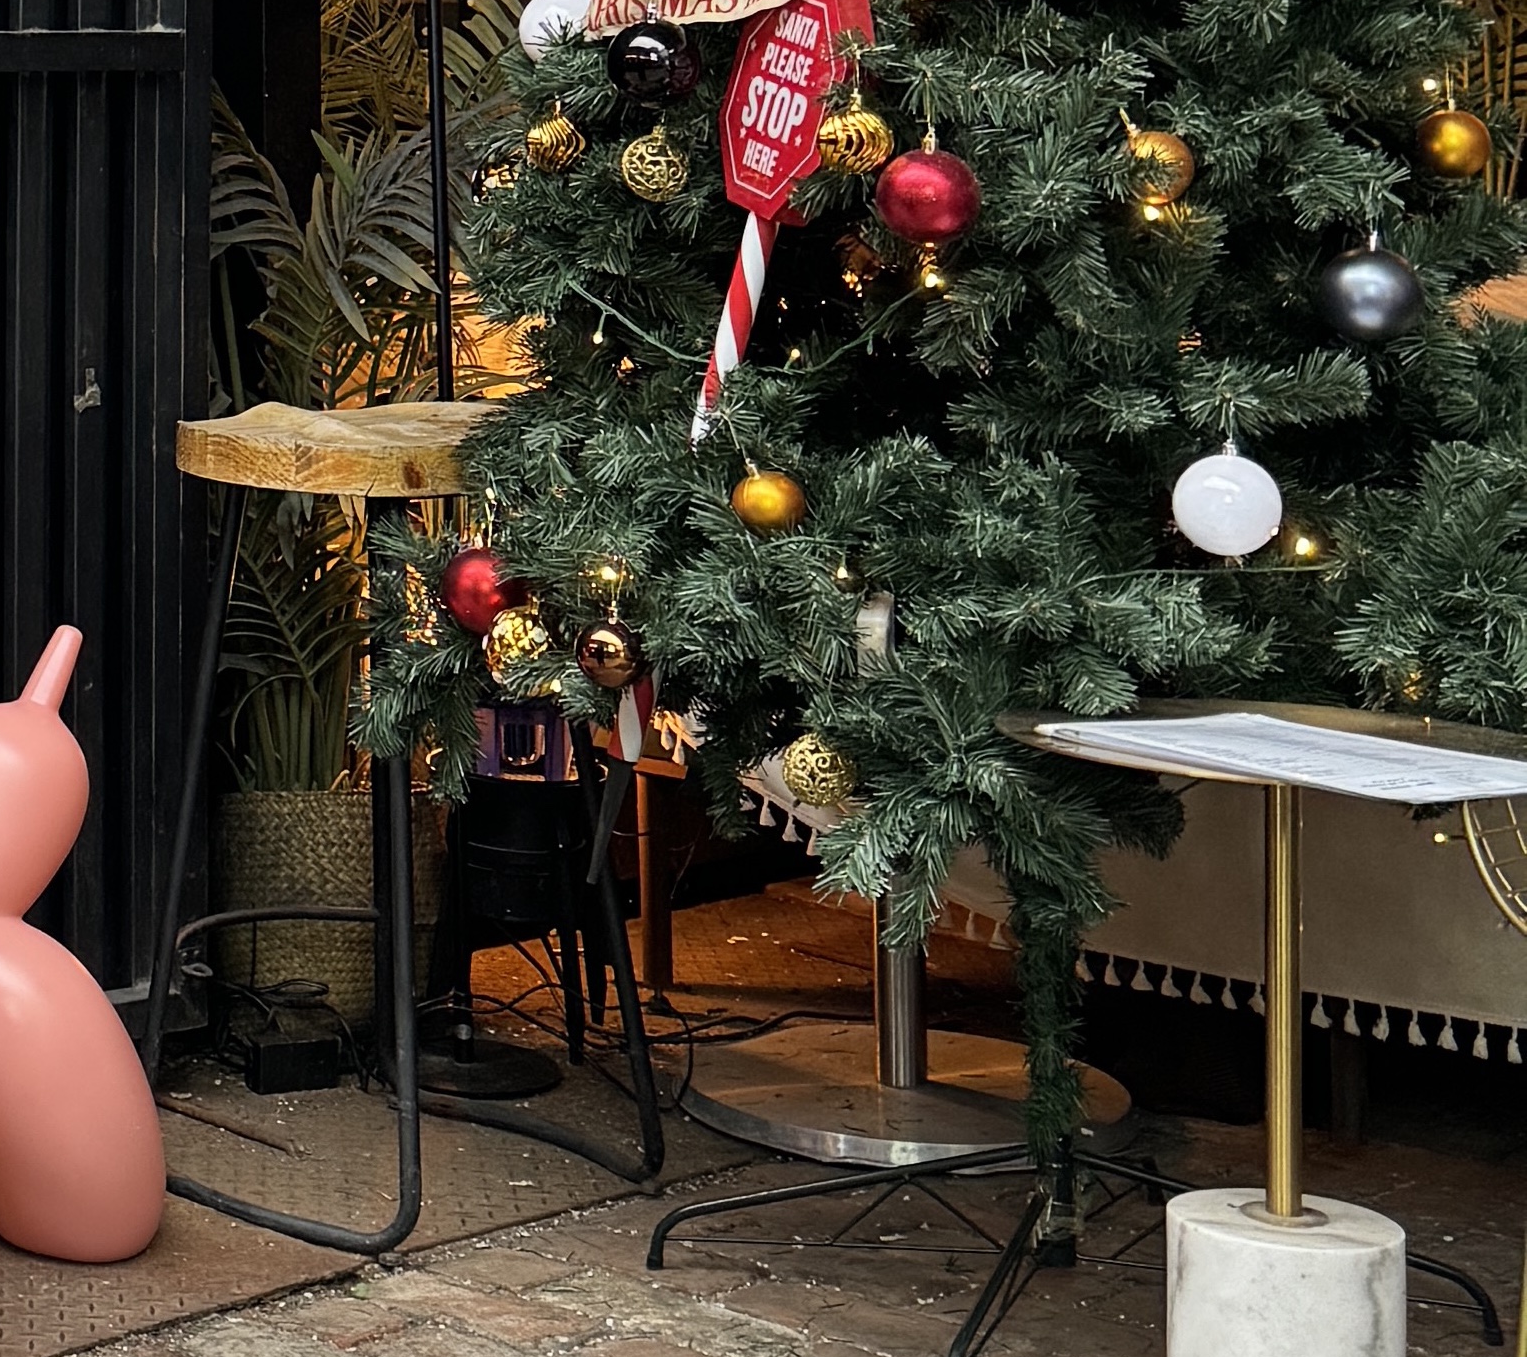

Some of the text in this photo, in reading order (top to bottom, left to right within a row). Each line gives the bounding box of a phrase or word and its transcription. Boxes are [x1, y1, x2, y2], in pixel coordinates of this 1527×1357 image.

[775, 9, 820, 51] SANTA
[760, 42, 814, 87] PLEASE
[741, 75, 808, 144] STOP
[742, 139, 780, 178] HERE
